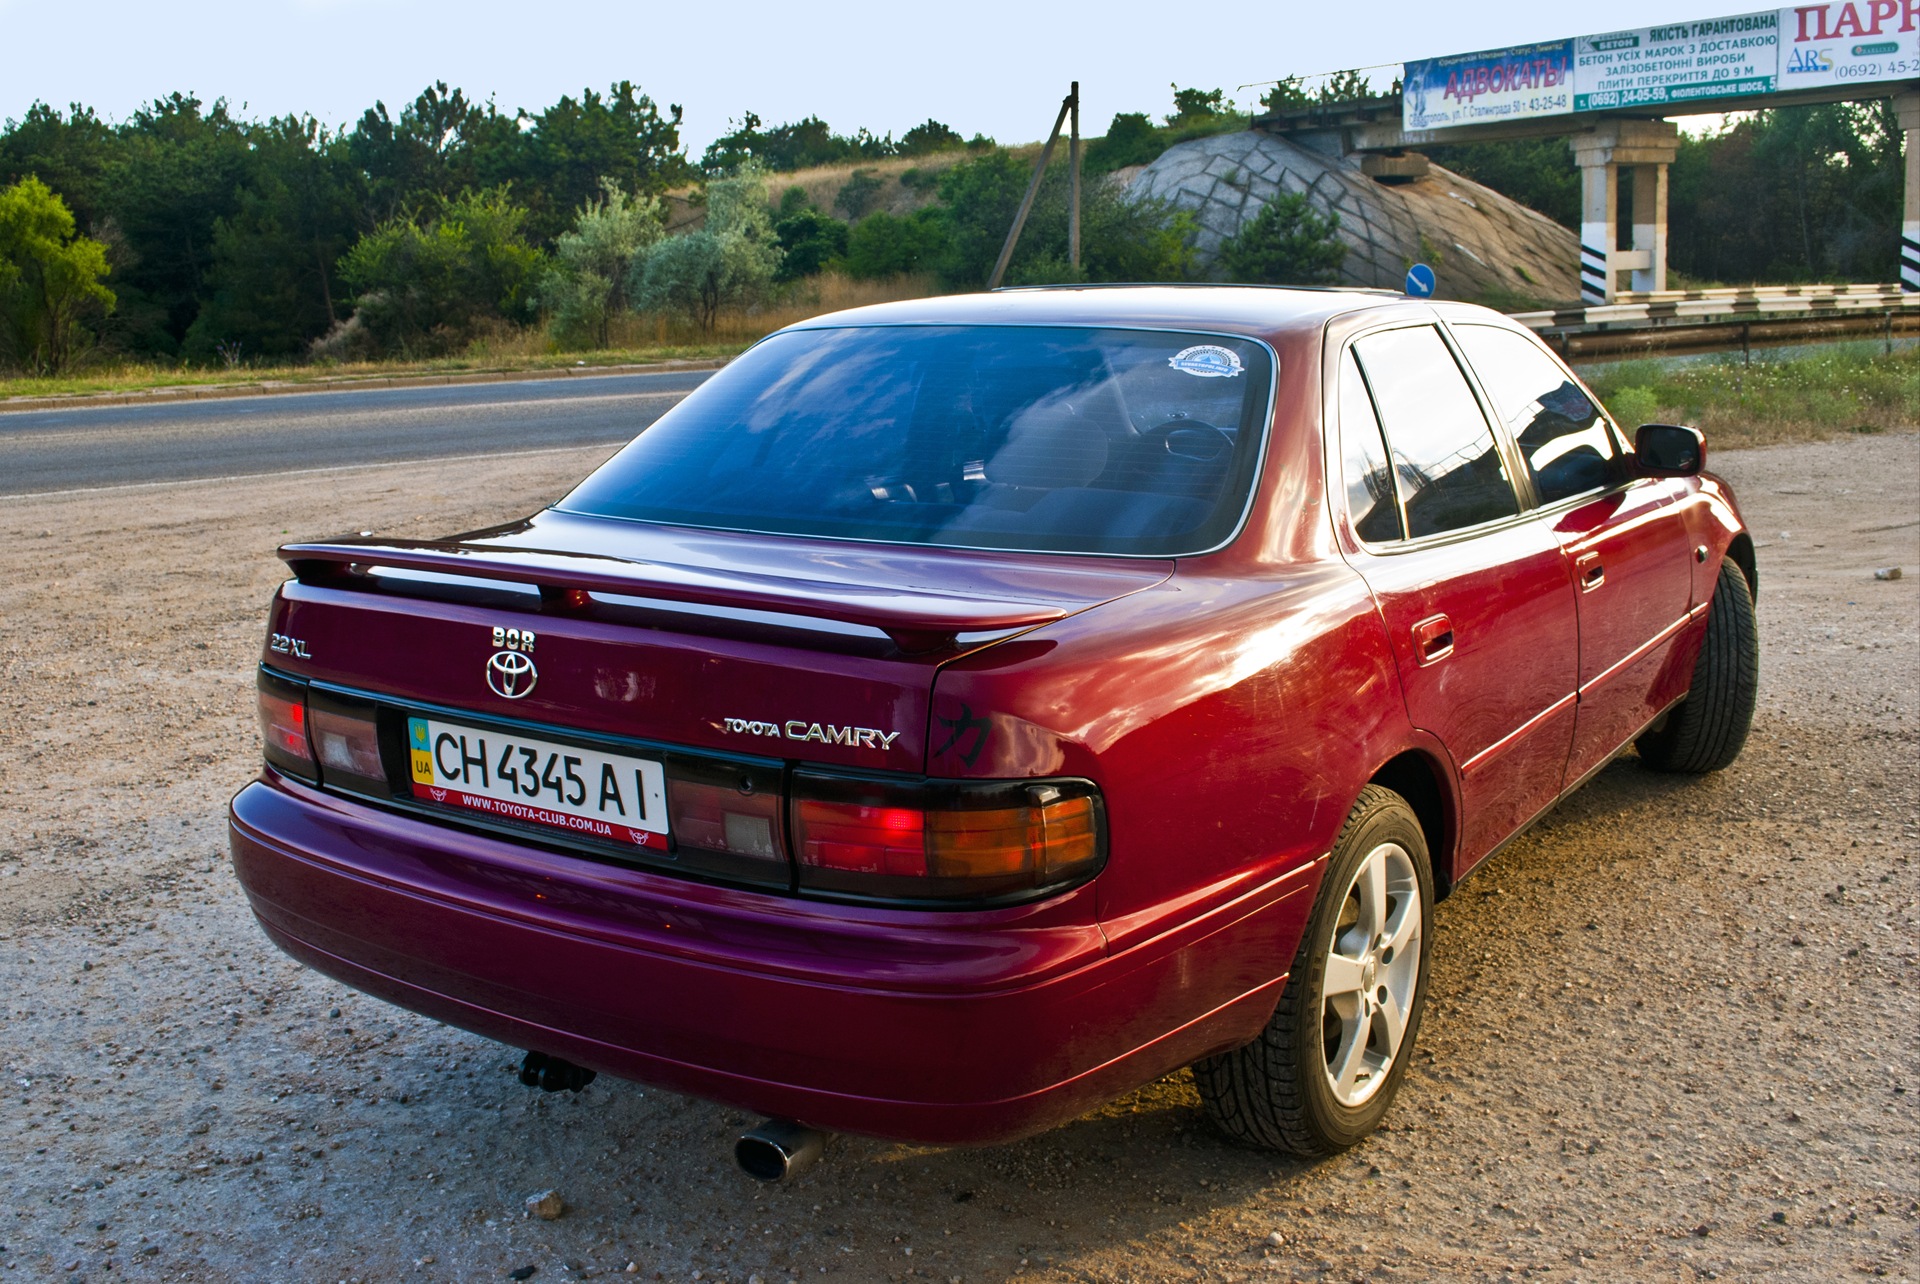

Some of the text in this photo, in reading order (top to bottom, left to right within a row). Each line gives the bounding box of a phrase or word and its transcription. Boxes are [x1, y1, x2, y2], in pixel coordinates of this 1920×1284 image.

[1649, 14, 1777, 43] ЯКІСТЬ ГАРАНТОВАНА
[1579, 54, 1613, 67] БЕТОН
[1645, 45, 1685, 59] МАРОК
[1699, 35, 1777, 54] ДОСТАВКОЮ
[1599, 38, 1634, 50] БЕТОН
[1697, 52, 1746, 67] ВИРОБИ
[1835, 64, 1882, 79] (0692)
[1443, 57, 1567, 104] АДВОКАТЫ
[1598, 66, 1754, 90] ПЛИТИ ПЕРЕКРИТТЯ ДО 9 М
[1529, 94, 1567, 112] 43-25-48
[1588, 91, 1619, 110] (0692)
[1621, 86, 1668, 104] 24-05-59,
[1738, 81, 1767, 93] ШОСЕ,
[723, 717, 901, 751] TOYOTA CAMRY
[416, 760, 432, 776] UA
[434, 731, 647, 821] CH 4345 AI
[461, 793, 612, 836] WWW.TOYOTA-CLUB.COM.UA
